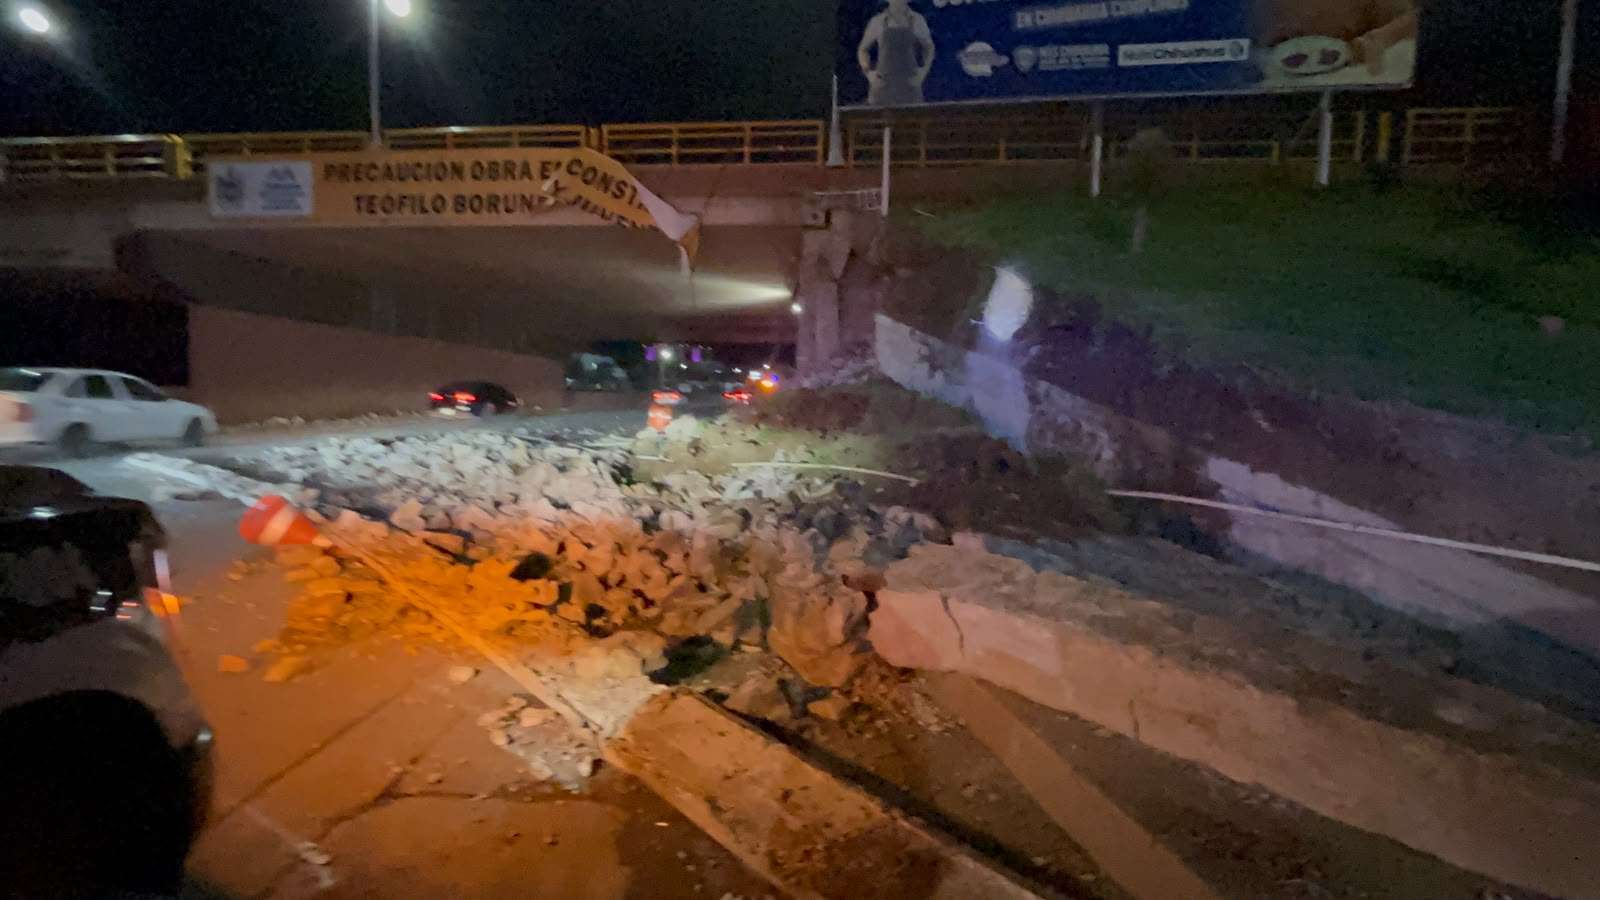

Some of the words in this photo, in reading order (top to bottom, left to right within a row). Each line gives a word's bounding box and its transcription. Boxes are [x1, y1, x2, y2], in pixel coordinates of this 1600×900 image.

[323, 160, 466, 183] PRECAUCION
[470, 160, 533, 181] OBRA
[353, 193, 447, 215] TEOFILO
